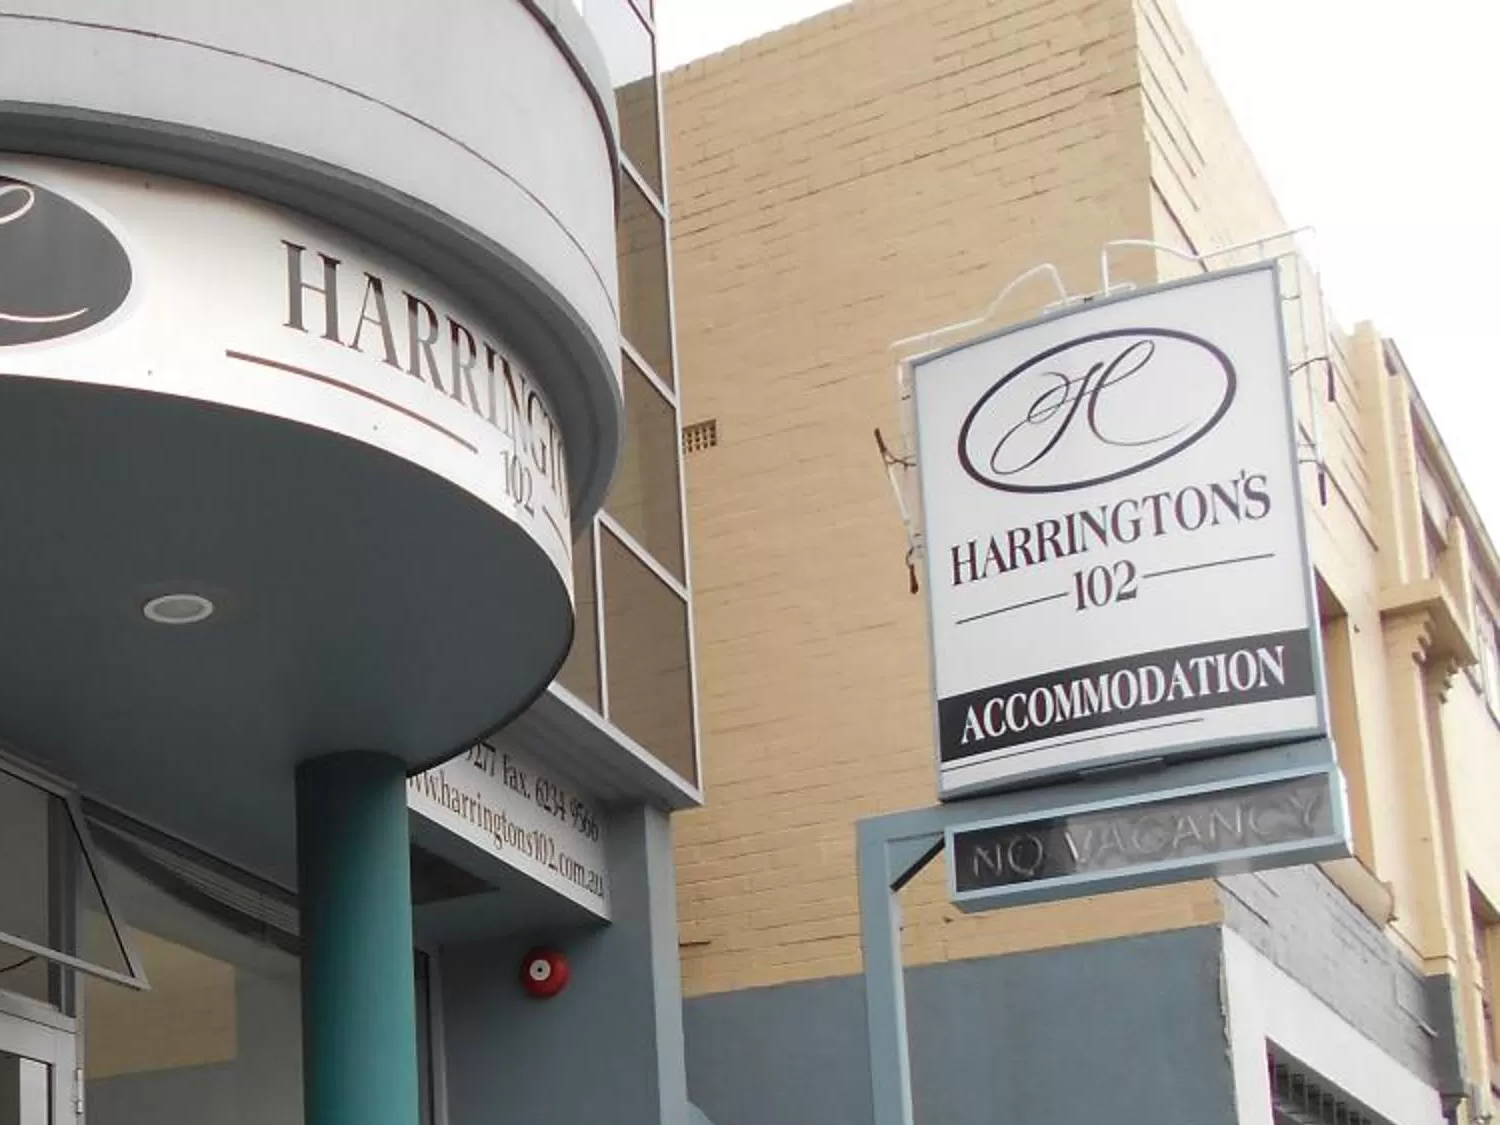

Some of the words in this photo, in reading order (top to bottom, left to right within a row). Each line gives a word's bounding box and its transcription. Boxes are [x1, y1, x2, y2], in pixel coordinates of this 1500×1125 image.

[500, 452, 534, 518] 102
[950, 470, 1272, 586] HARRINGTON'S
[1075, 560, 1138, 611] 102
[961, 646, 1286, 744] ACCOMMODATION
[973, 832, 1043, 877] NO
[1064, 788, 1322, 864] VACANCY
